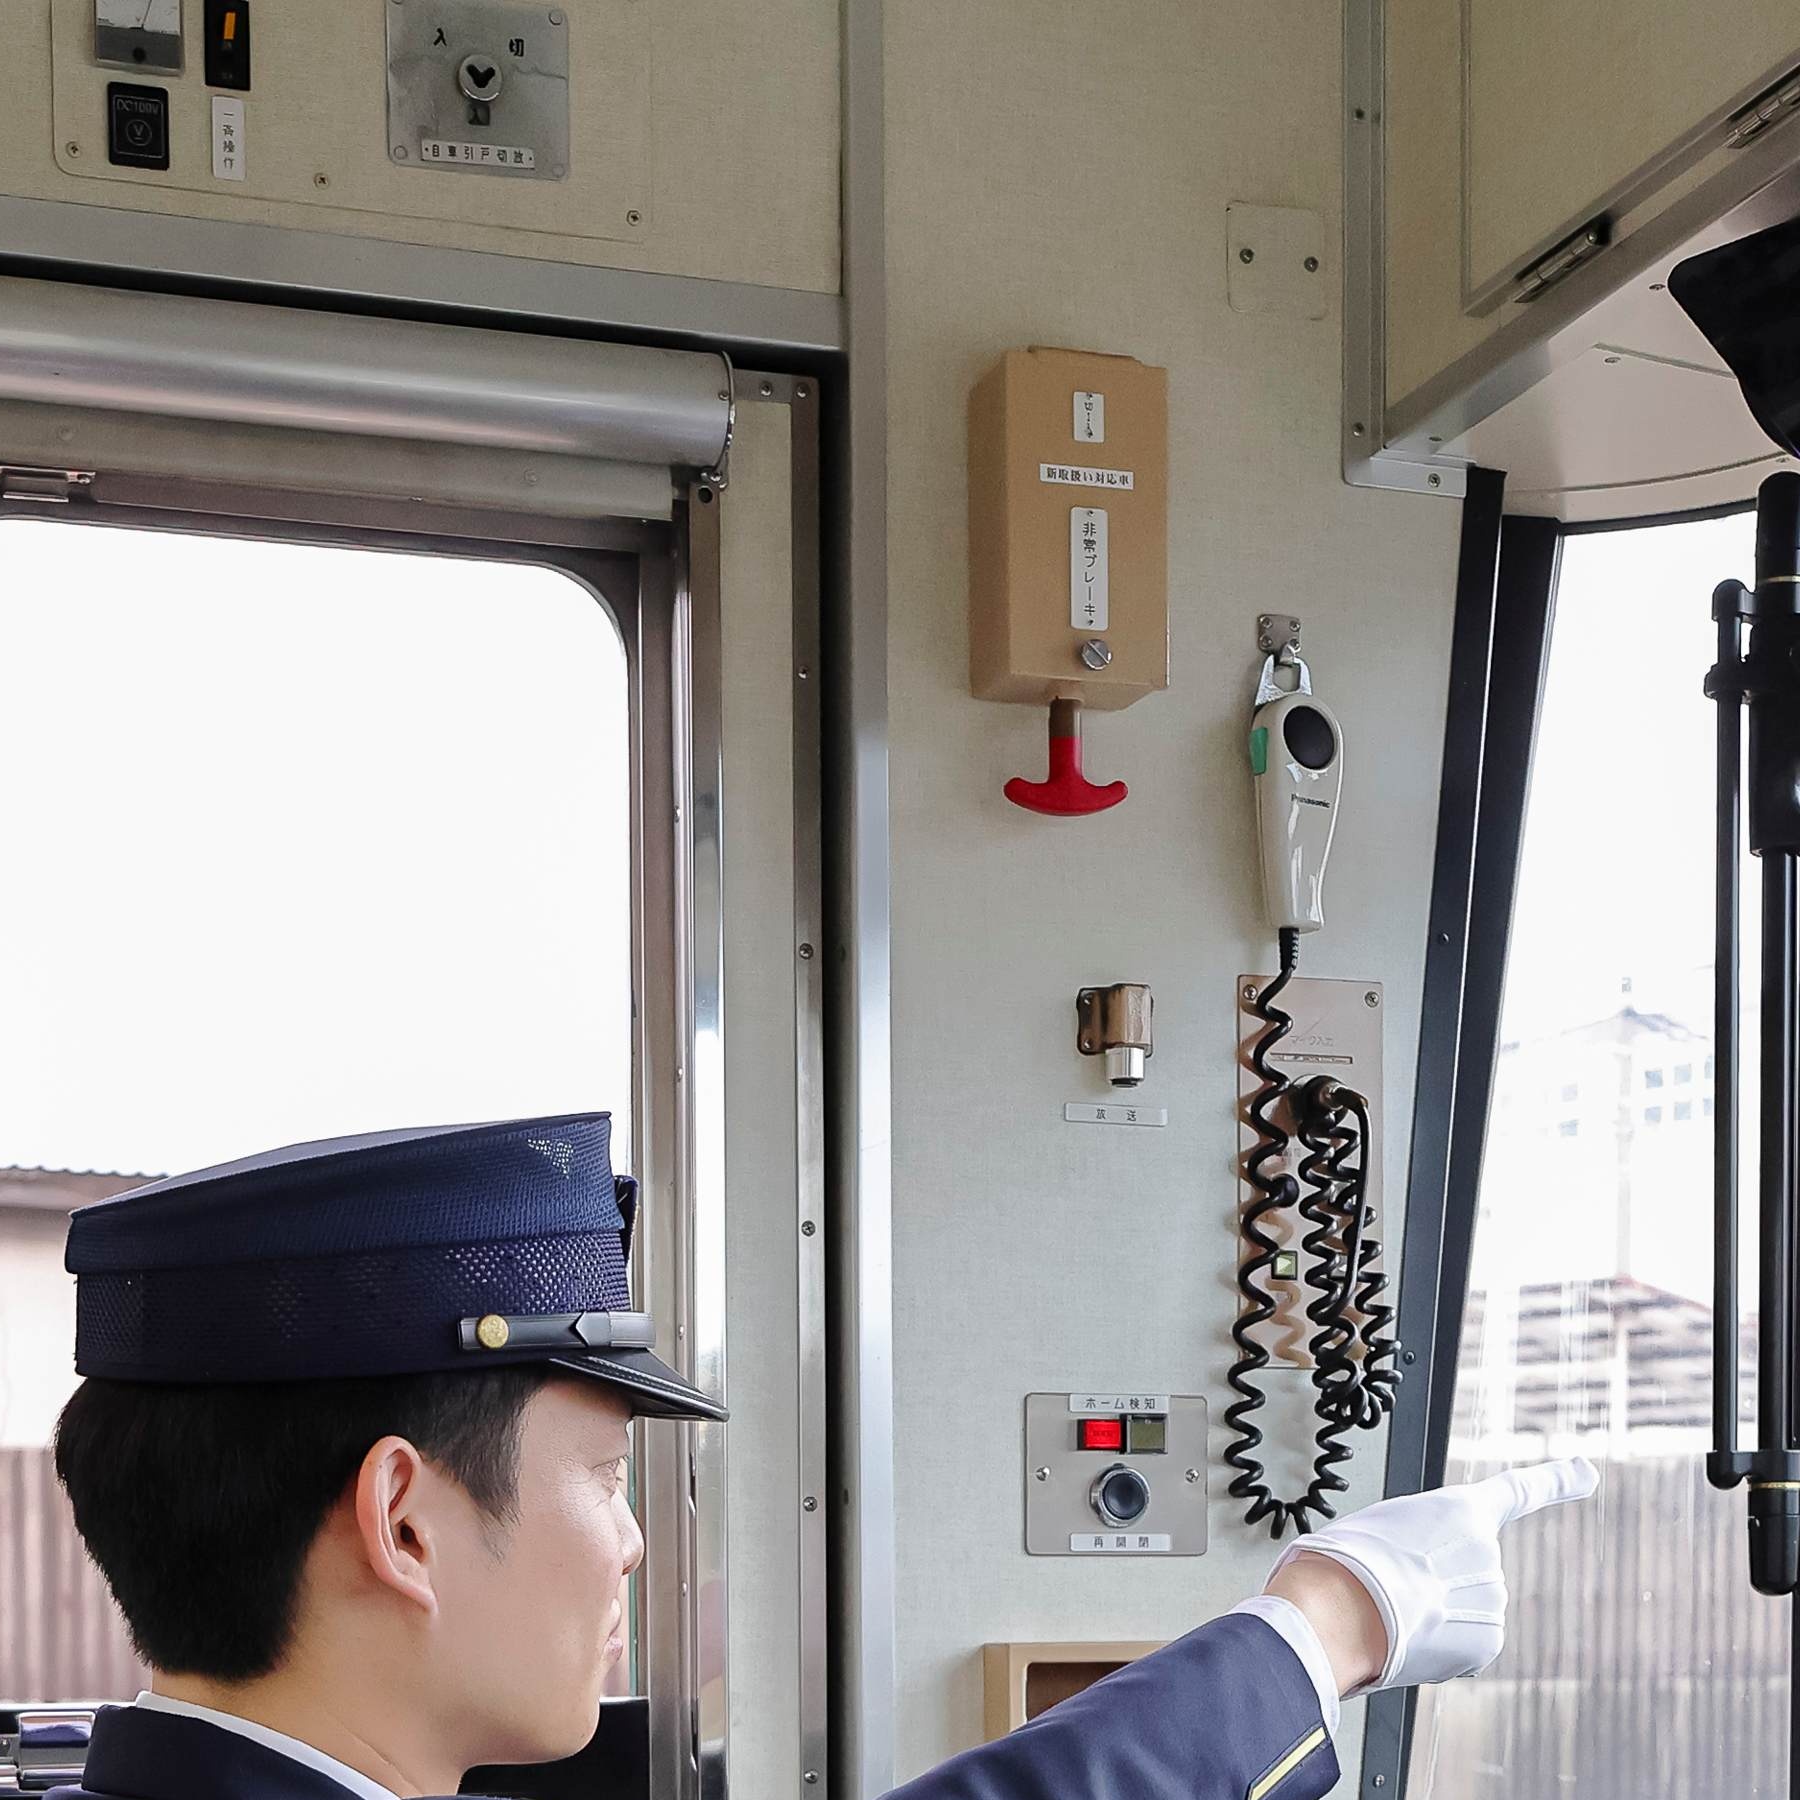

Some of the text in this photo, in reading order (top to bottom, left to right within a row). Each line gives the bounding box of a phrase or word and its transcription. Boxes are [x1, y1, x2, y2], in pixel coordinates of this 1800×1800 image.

[433, 27, 447, 47] 入
[508, 38, 524, 57] 切
[1046, 466, 1131, 487] 新取扱い対応車
[1082, 521, 1098, 617] 非常ブレーキ
[1096, 1108, 1137, 1122] 放送
[1084, 1397, 1157, 1411] ホーム検知
[1093, 1535, 1150, 1550] 再開閉
